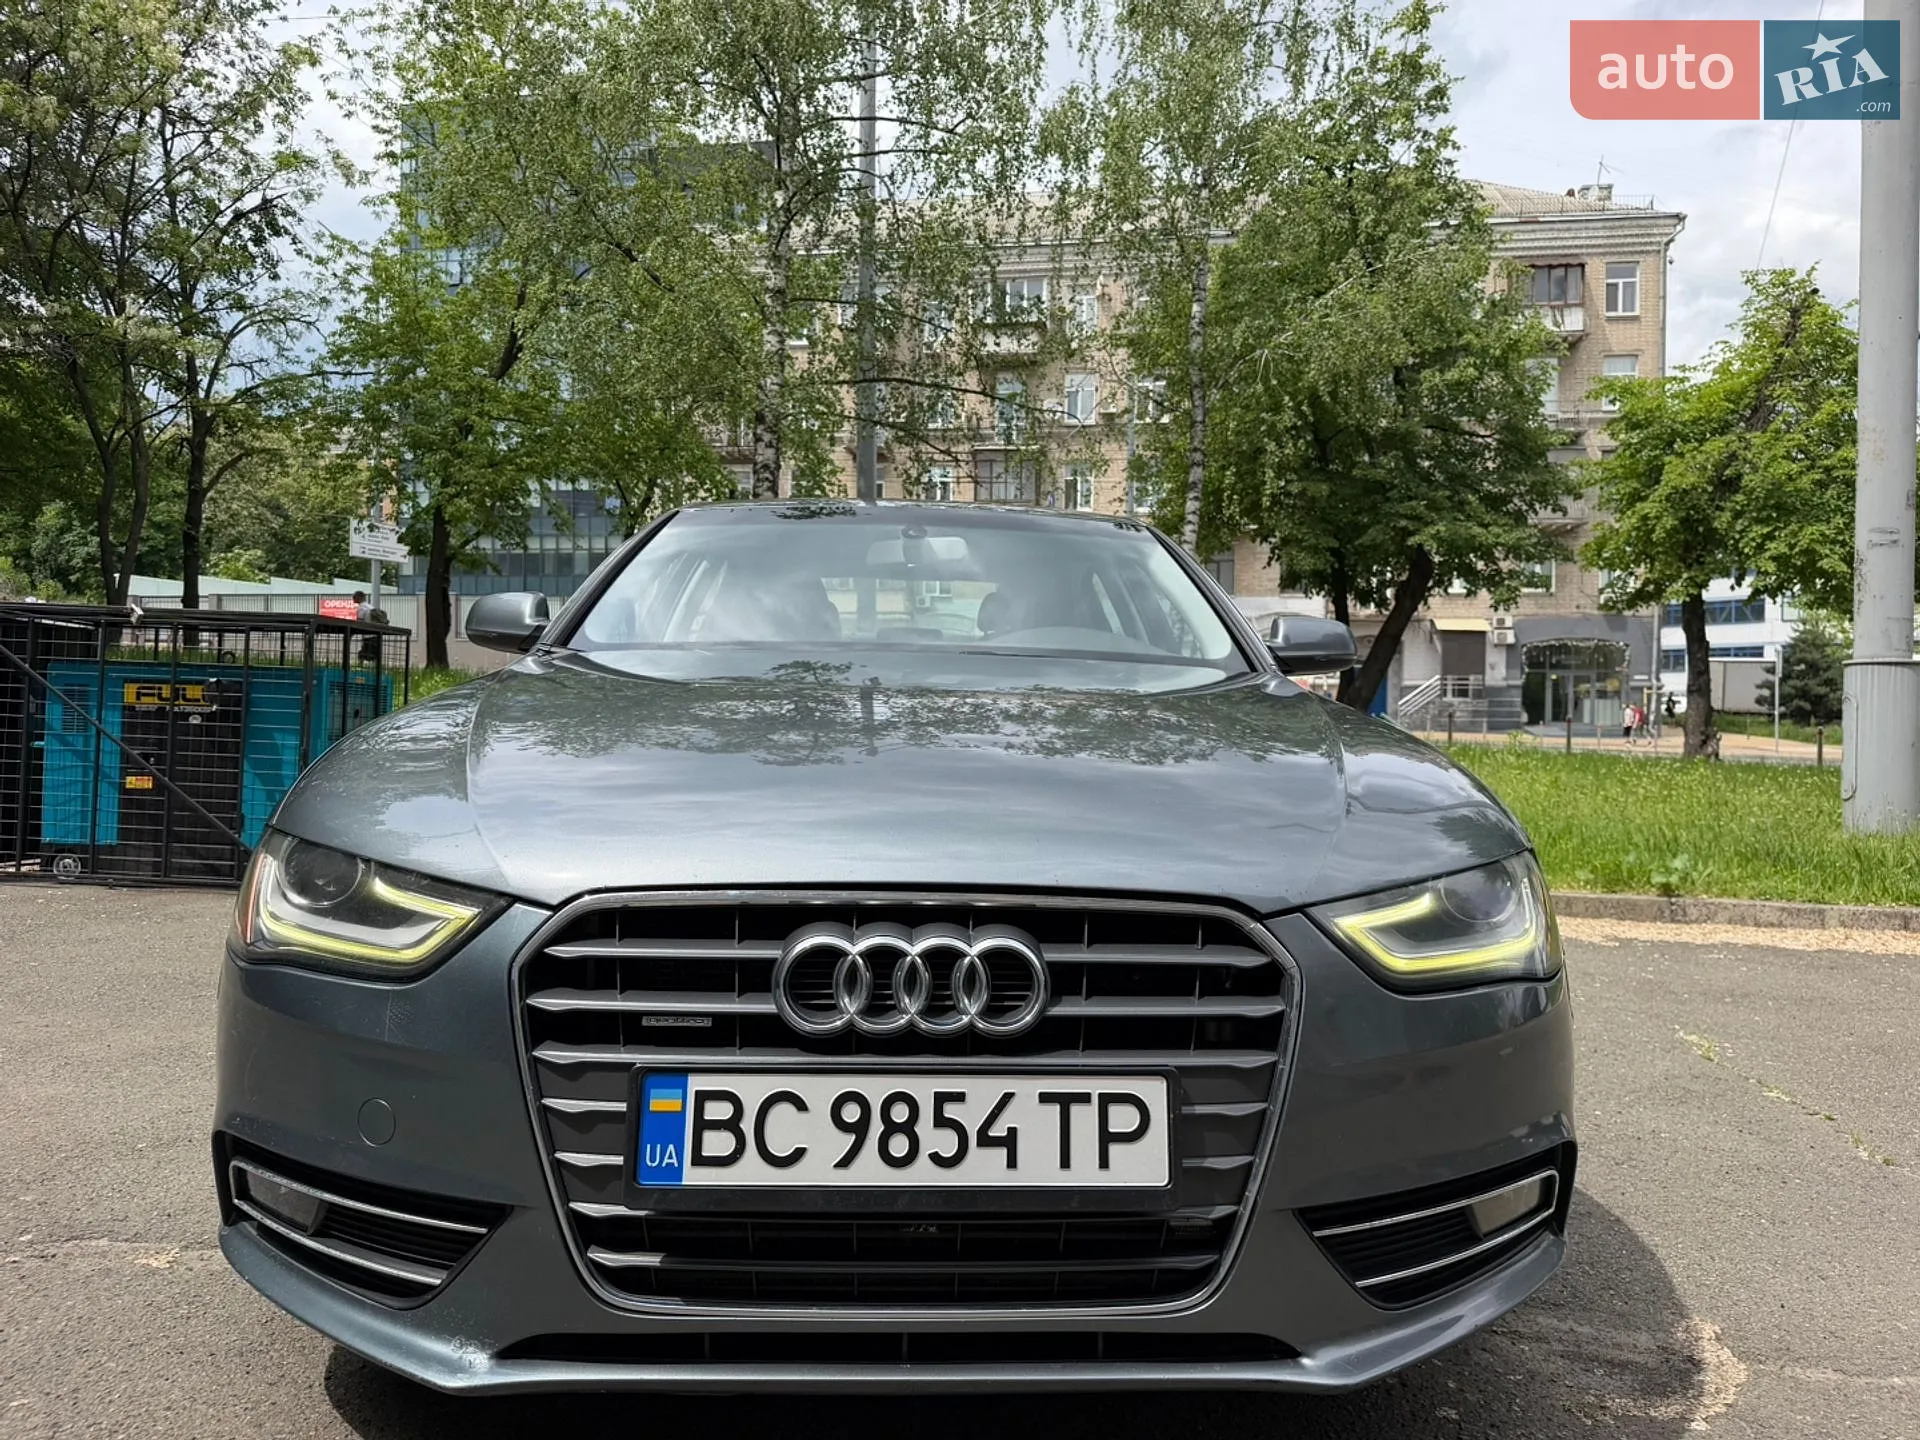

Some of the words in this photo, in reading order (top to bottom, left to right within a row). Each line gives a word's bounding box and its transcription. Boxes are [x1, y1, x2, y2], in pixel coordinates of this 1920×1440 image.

[324, 600, 356, 608] ОРЕНД
[690, 1089, 810, 1168] BC
[829, 1090, 1018, 1170] 9854
[1037, 1092, 1152, 1170] TP
[645, 1143, 679, 1168] UA
